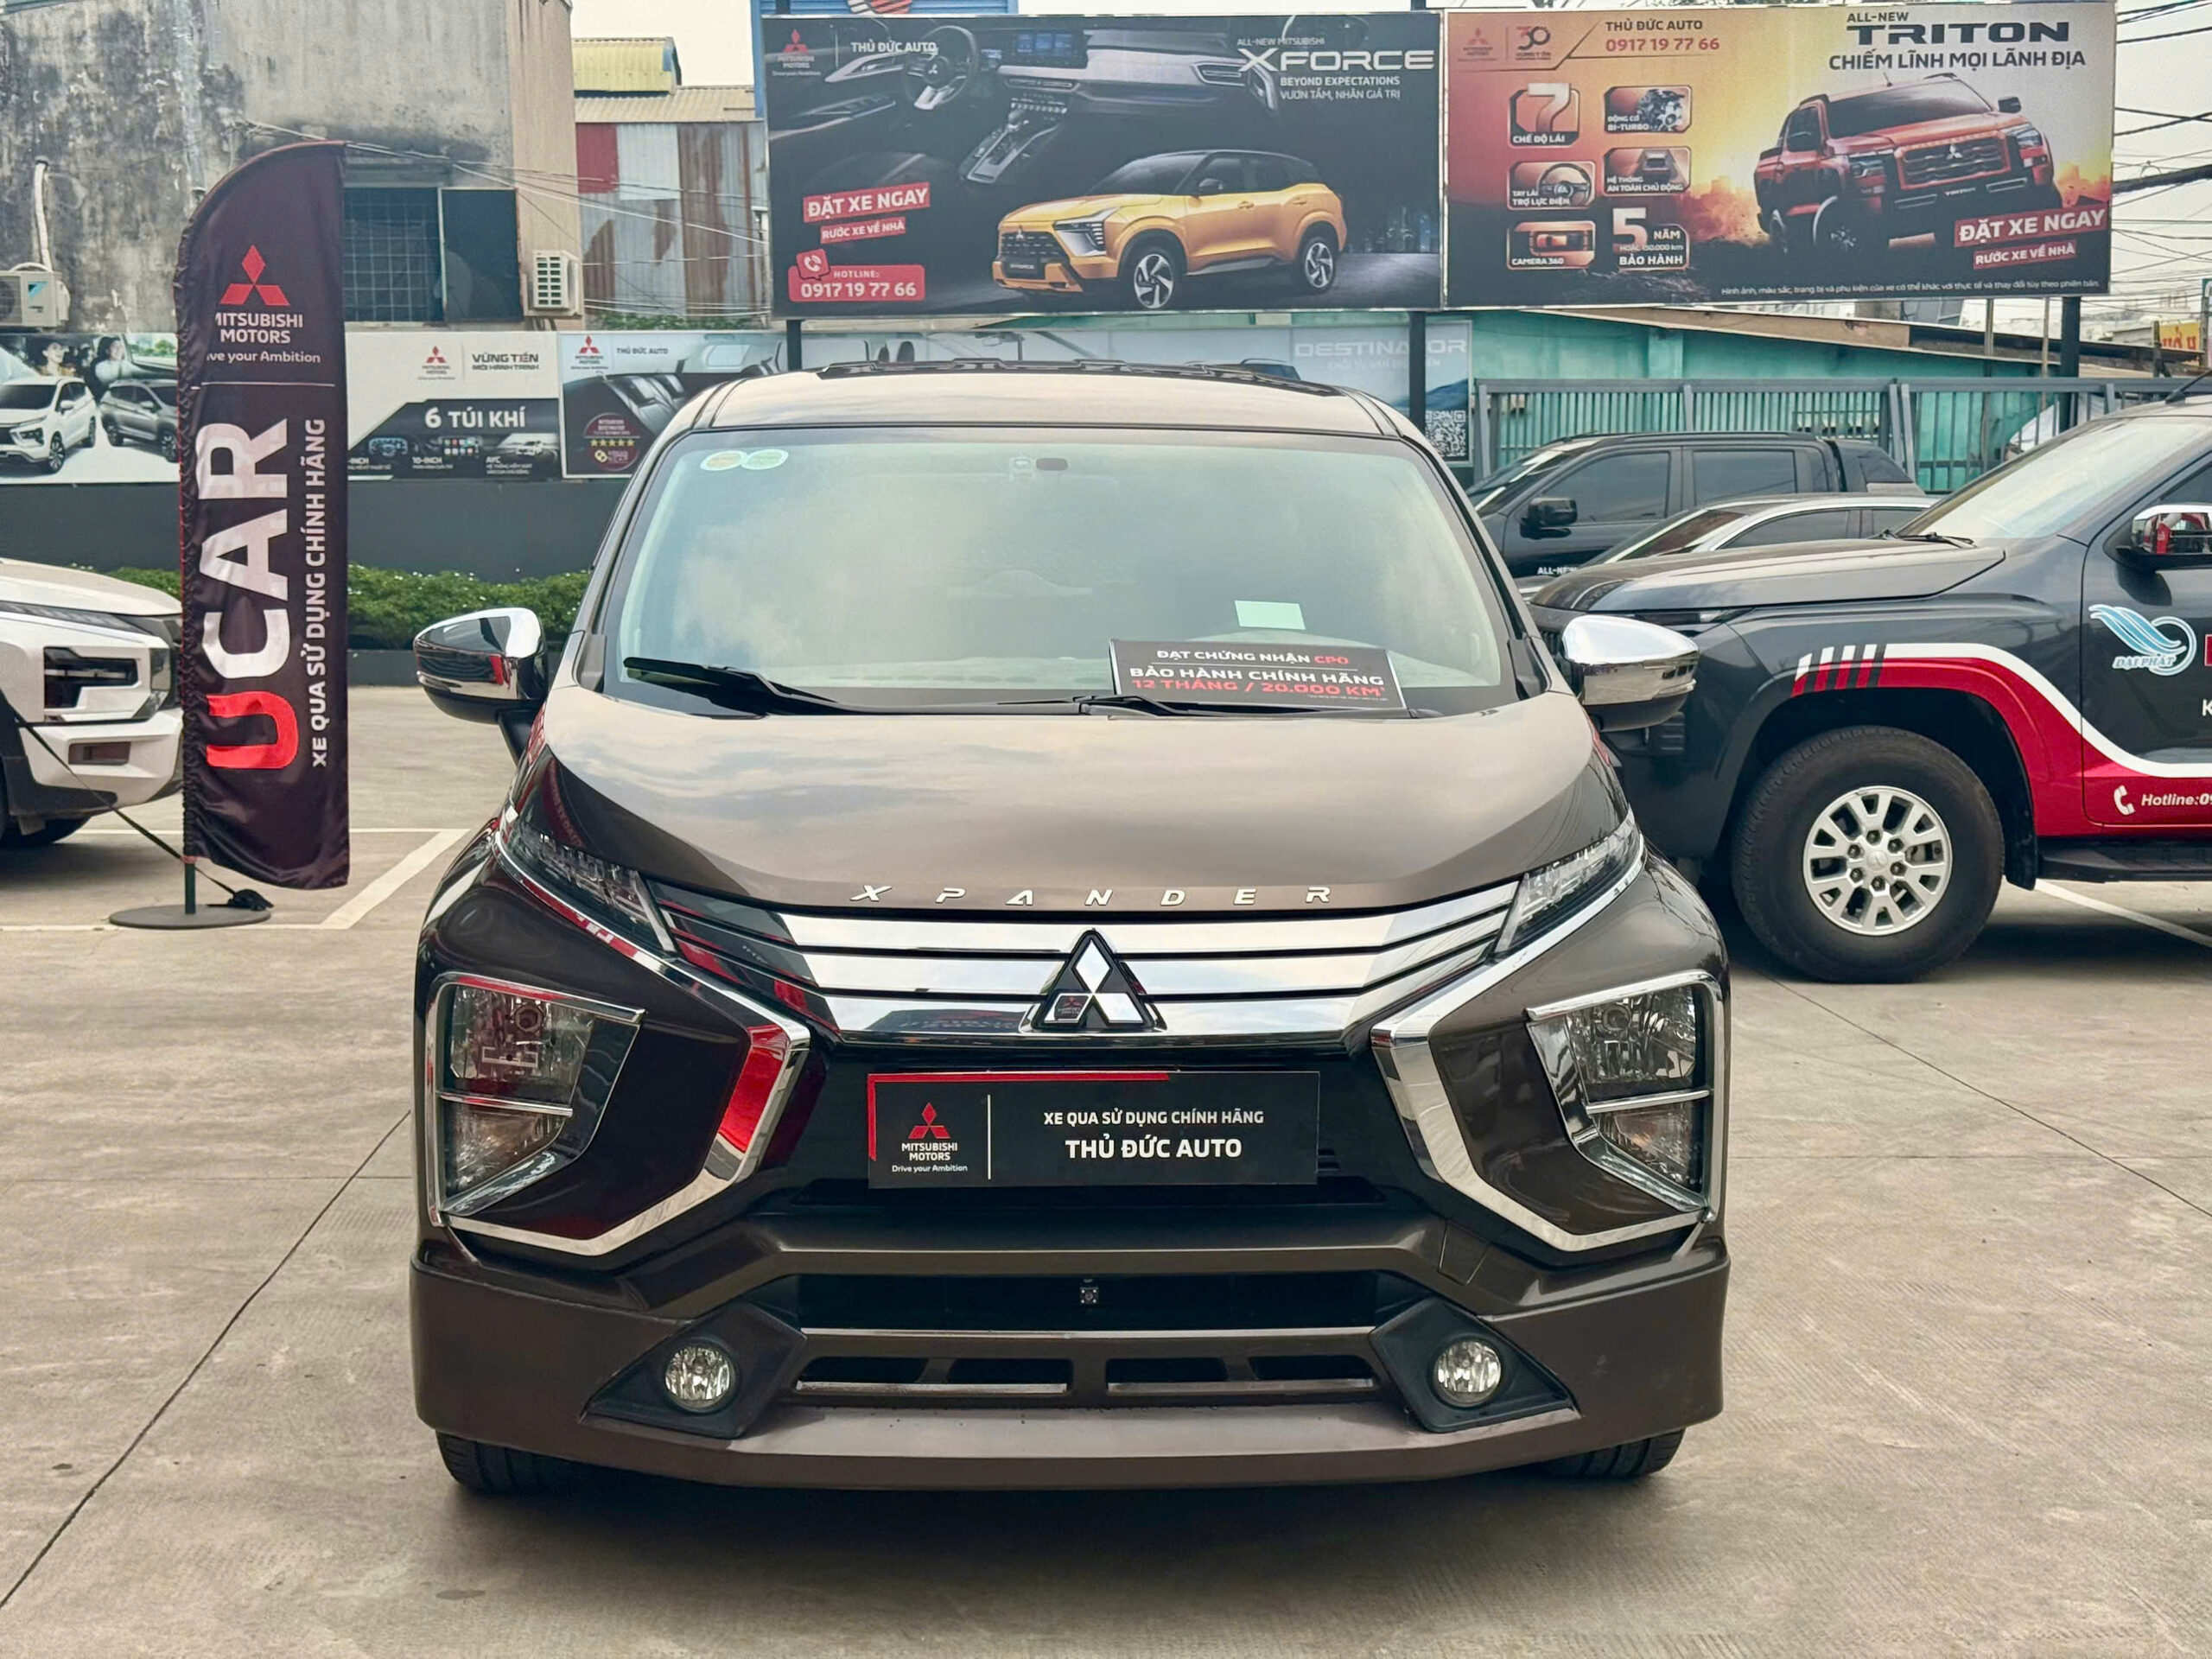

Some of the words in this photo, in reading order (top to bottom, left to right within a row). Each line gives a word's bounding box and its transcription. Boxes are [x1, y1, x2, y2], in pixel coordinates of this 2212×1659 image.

[1605, 18, 1632, 31] THỦ
[1637, 18, 1663, 30] ĐỨC
[1666, 20, 1702, 30] AUTO
[1847, 12, 1909, 22] ALL-NEW
[1847, 22, 2069, 45] TRITON
[904, 41, 938, 52] AUTO
[1605, 39, 1646, 52] 0917
[1650, 38, 1669, 50] 19
[1674, 38, 1694, 50] 77
[1698, 38, 1719, 50] 66
[1237, 48, 1435, 72] XFORCE
[1829, 48, 1892, 70] CHIẾM
[1899, 50, 1944, 69] LĨNH
[1949, 52, 1986, 71] MỌI
[1993, 48, 2046, 67] LÃNH
[2051, 51, 2086, 69] ĐỊA
[1281, 76, 1322, 86] BEYOND
[1325, 76, 1401, 86] EXPECTATIONS
[1529, 83, 1571, 132] 7
[808, 196, 844, 219] ĐẶT
[849, 195, 872, 213] XE
[877, 188, 928, 209] NGAY
[852, 225, 865, 236] XE
[1612, 207, 1648, 254] 5
[1653, 228, 1681, 239] NĂM
[1960, 218, 2004, 244] ĐẶT
[2008, 217, 2037, 238] XE
[2044, 209, 2106, 232] NGAY
[1619, 252, 1645, 265] BẢO
[1648, 252, 1684, 265] HÀNH
[1975, 250, 2009, 265] RƯỚC
[2011, 248, 2027, 261] XE
[2030, 245, 2046, 258] VỀ
[2048, 243, 2075, 256] NHÀ
[801, 283, 842, 298] 0917
[846, 283, 865, 297] 19
[869, 283, 890, 297] 77
[894, 283, 917, 297] 66
[220, 329, 291, 344] MOTORS
[227, 352, 258, 364] your
[260, 351, 321, 363] Ambition
[1296, 340, 1467, 357] DESTINAOR
[425, 407, 442, 429] 6
[448, 406, 483, 429] TÚI
[489, 406, 526, 429] KHÍ
[300, 419, 326, 486] HÃNG
[300, 493, 326, 567] CHÍNH
[195, 418, 299, 769] UCAR
[305, 573, 330, 639] DỤNG
[300, 643, 326, 677] SỬ
[1157, 650, 1191, 661] ĐẠT
[1194, 650, 1255, 661] CHỨNG
[1259, 652, 1310, 664] NHẬN
[1314, 655, 1350, 664] CPO
[1130, 664, 1174, 678] BẢO
[1179, 667, 1243, 680] HÀNH
[1249, 670, 1316, 683] CHÍNH
[1321, 672, 1383, 685] HÃNG
[1132, 679, 1155, 690] 12
[1160, 678, 1238, 690] THÁNG
[1262, 683, 1340, 695] 20.000
[308, 681, 330, 731] QUA
[312, 737, 327, 767] XE
[2141, 792, 2212, 806] Hotline:0
[850, 886, 1332, 906] XPANDER
[1044, 1112, 1063, 1125] XE
[1067, 1112, 1098, 1127] QUA
[1102, 1108, 1122, 1125] SỬ
[1126, 1111, 1166, 1127] DỤNG
[1172, 1108, 1217, 1124] CHÍNH
[1222, 1108, 1263, 1124] HÃNG
[901, 1142, 958, 1151] MITSUBISHI
[1065, 1133, 1115, 1159] THỦ
[1121, 1134, 1170, 1158] ĐỨC
[1176, 1139, 1242, 1158] AUTO
[909, 1152, 951, 1161] MOTORS
[932, 1164, 968, 1173] Ambition
